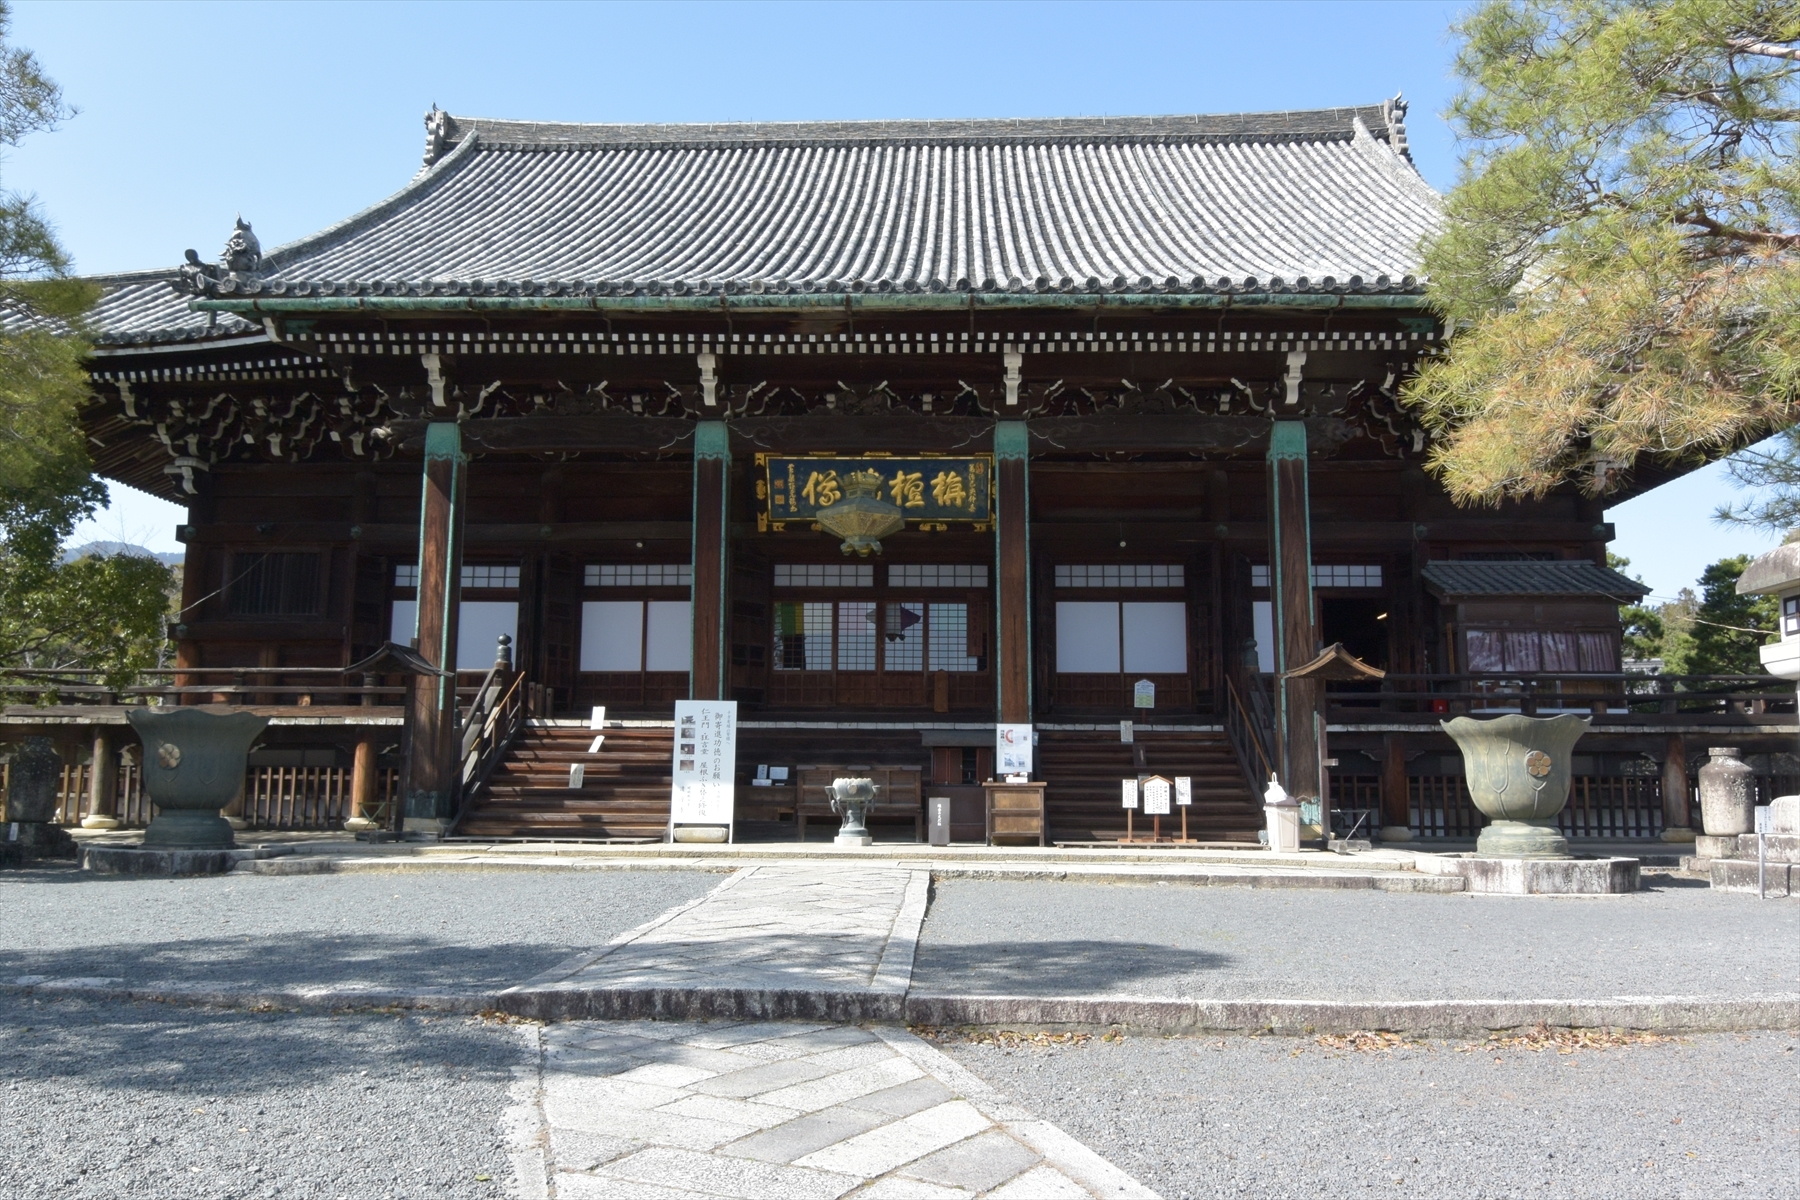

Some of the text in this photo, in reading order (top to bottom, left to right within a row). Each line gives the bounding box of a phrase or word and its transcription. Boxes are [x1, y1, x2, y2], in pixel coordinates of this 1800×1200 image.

[802, 468, 966, 508] 栴檀像
[701, 708, 710, 729] 仁王門
